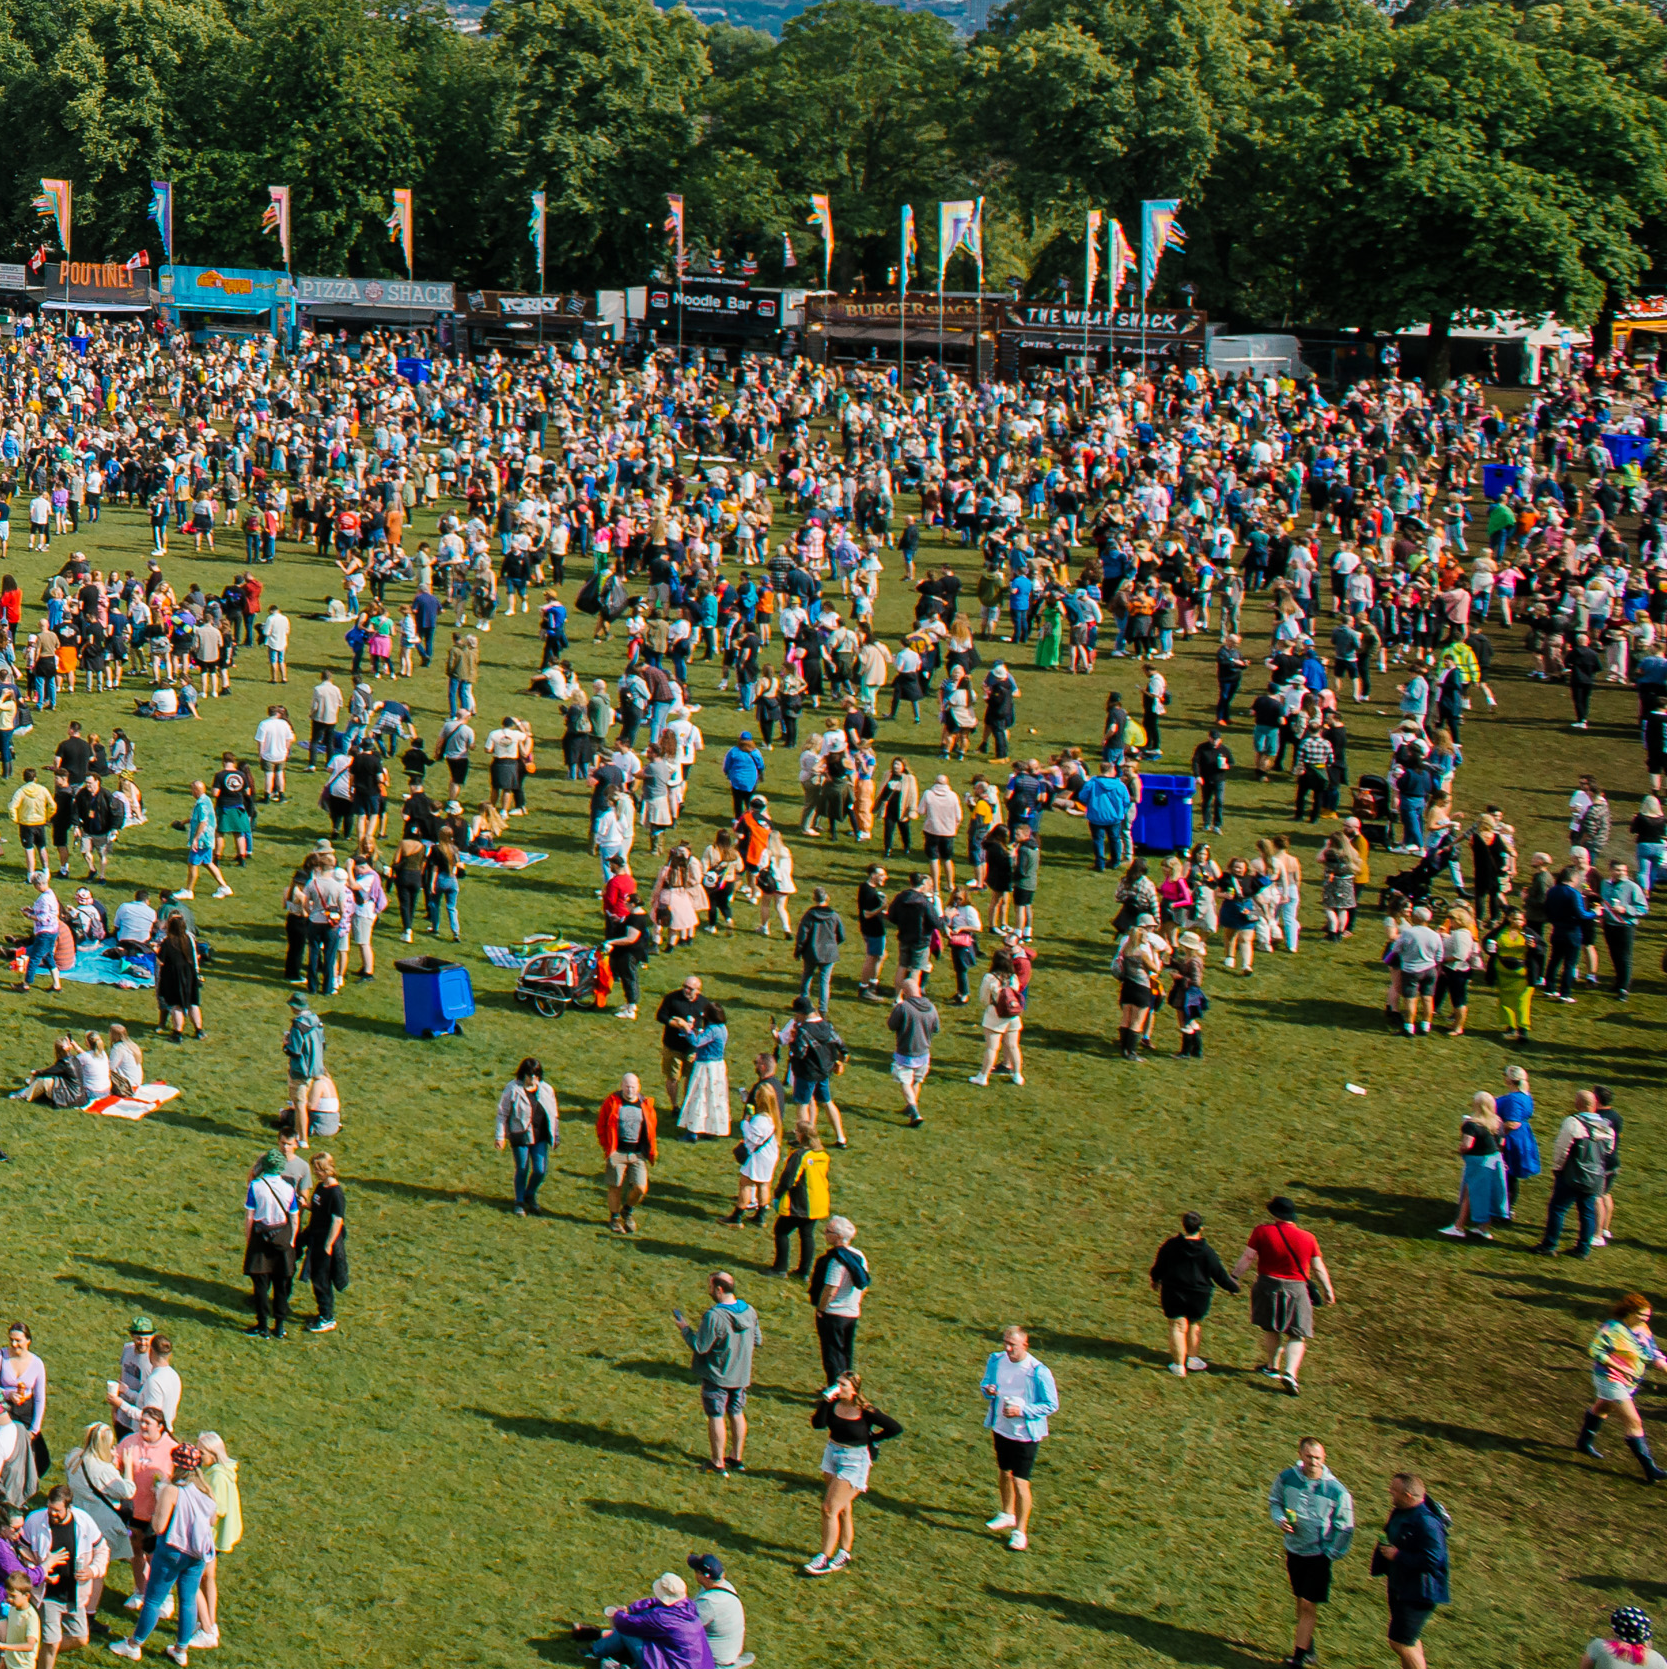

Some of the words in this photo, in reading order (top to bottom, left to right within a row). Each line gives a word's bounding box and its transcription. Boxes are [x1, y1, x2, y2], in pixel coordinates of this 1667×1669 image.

[59, 260, 134, 289] POUTINE!
[302, 281, 361, 299] PIZZA
[388, 285, 451, 304] SHACK
[673, 292, 721, 307] Noodle
[727, 296, 752, 310] Bar
[845, 302, 925, 317] BURGER
[926, 305, 976, 315] SHACK
[1026, 308, 1061, 323] THE
[1063, 309, 1114, 325] WRAP
[1117, 313, 1177, 330] SHACK
[1019, 340, 1054, 349] CHIPS
[1057, 342, 1103, 352] CHEESE
